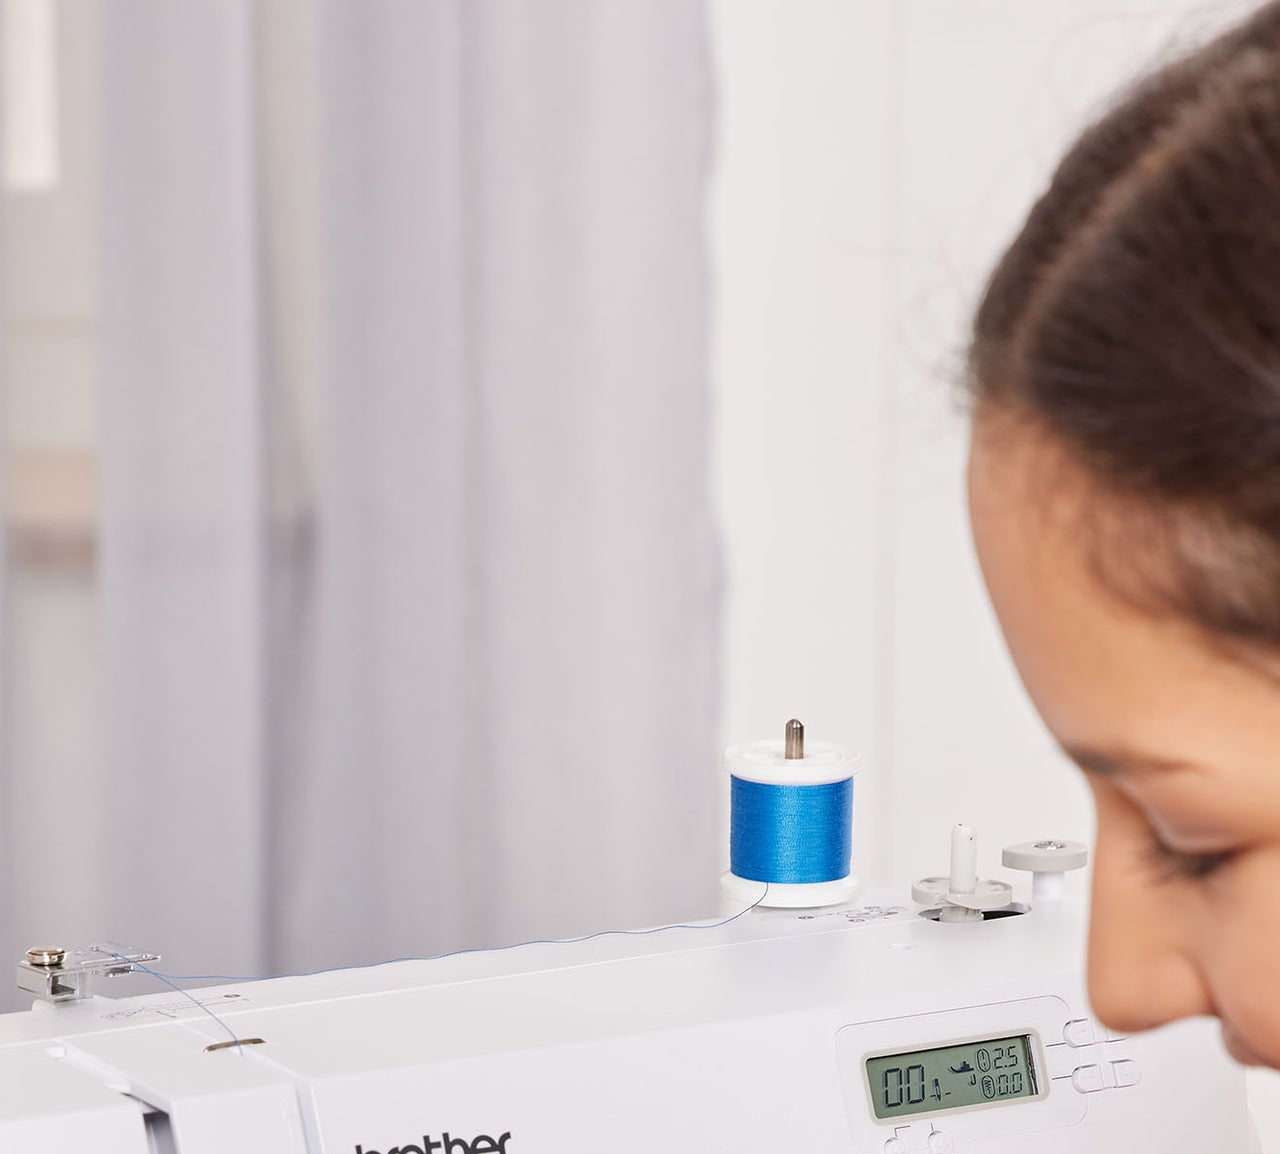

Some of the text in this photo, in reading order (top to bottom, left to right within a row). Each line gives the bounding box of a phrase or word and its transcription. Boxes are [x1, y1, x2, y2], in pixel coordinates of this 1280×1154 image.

[993, 1045, 1018, 1070] 2.5
[883, 1064, 925, 1108] 00
[998, 1071, 1023, 1096] 0.0
